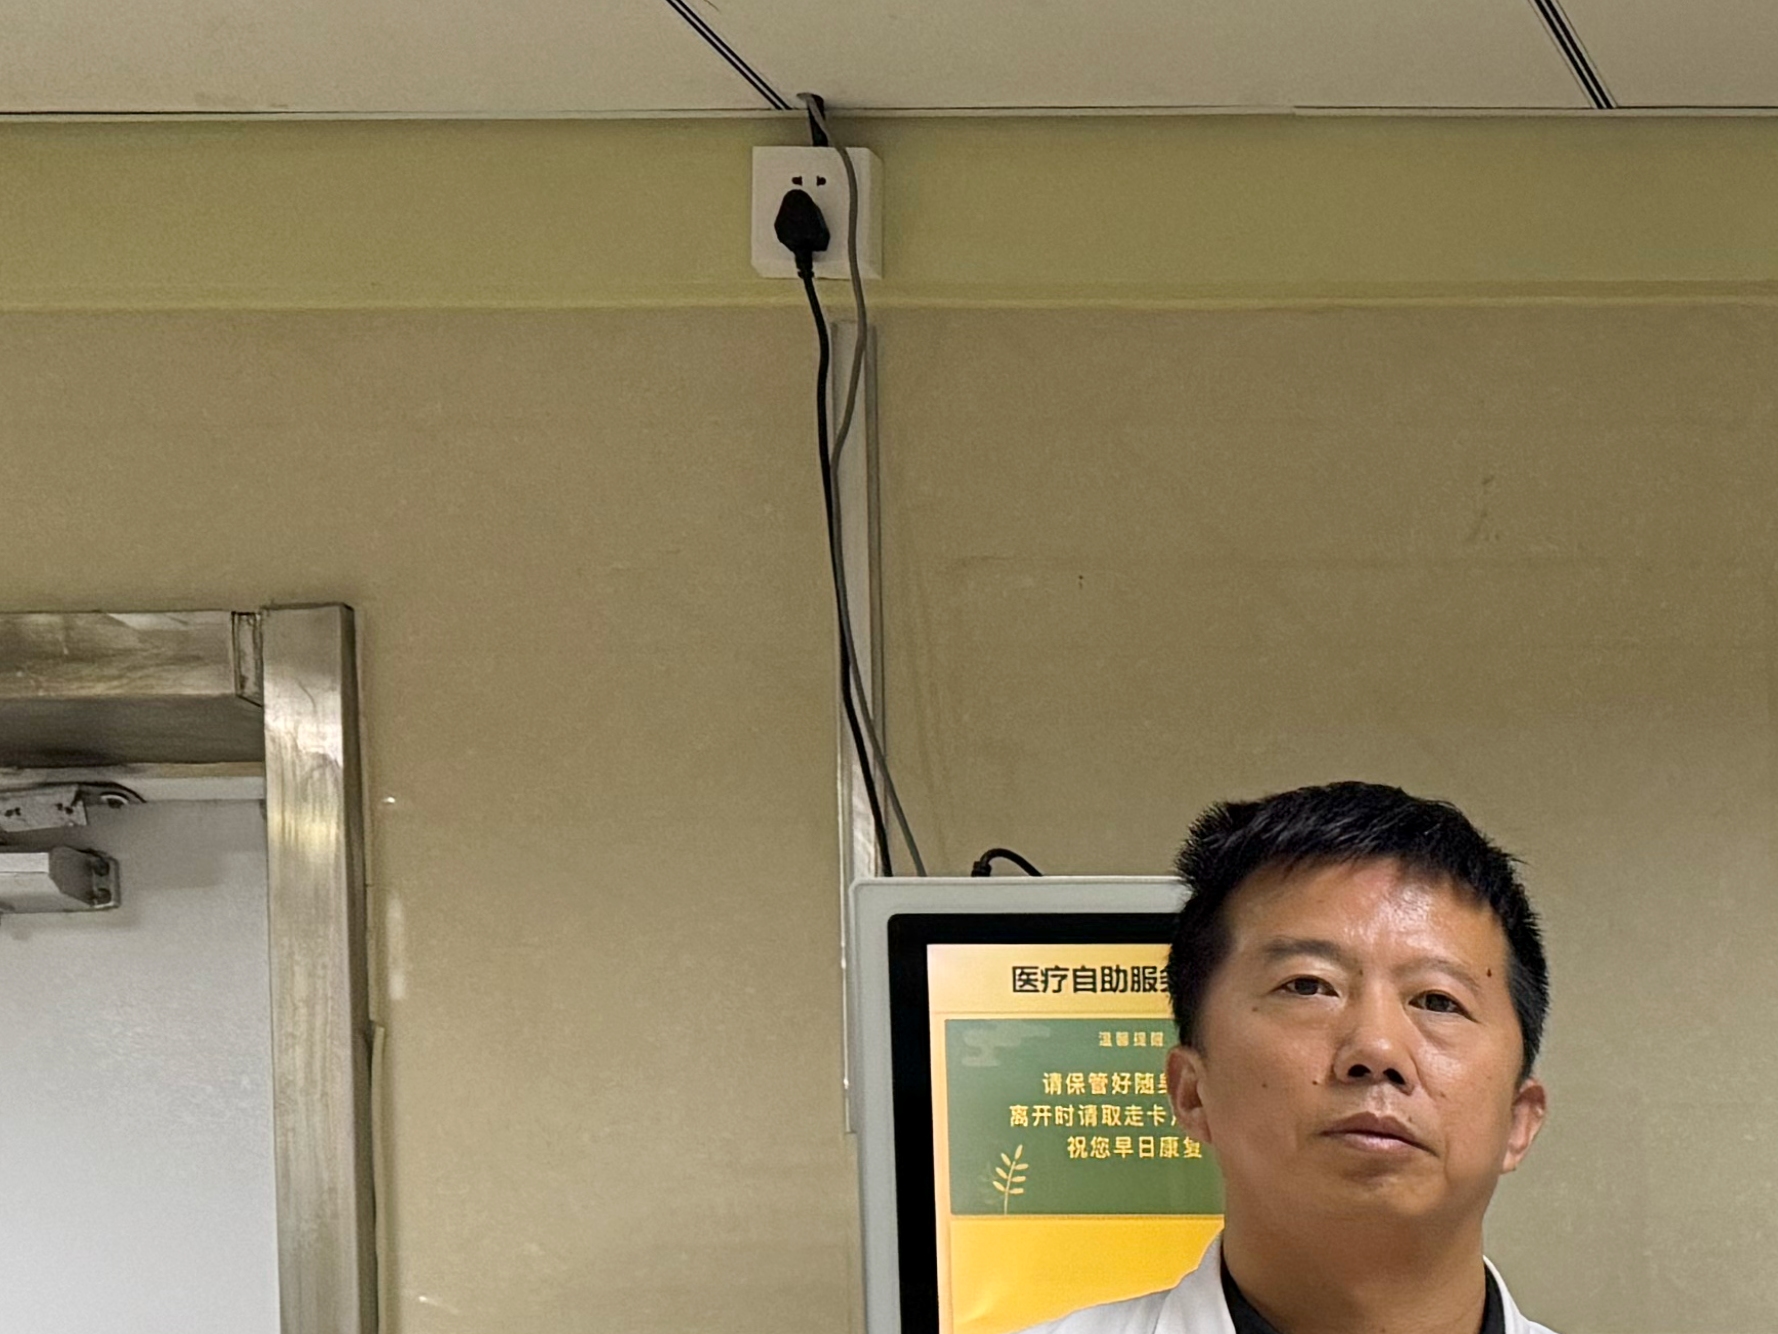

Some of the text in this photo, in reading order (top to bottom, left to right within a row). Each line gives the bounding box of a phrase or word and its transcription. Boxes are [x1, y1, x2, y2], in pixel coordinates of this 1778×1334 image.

[1009, 1103, 1178, 1128] 离开时请取走卡
[1066, 1136, 1203, 1159] 祝您早日康复
